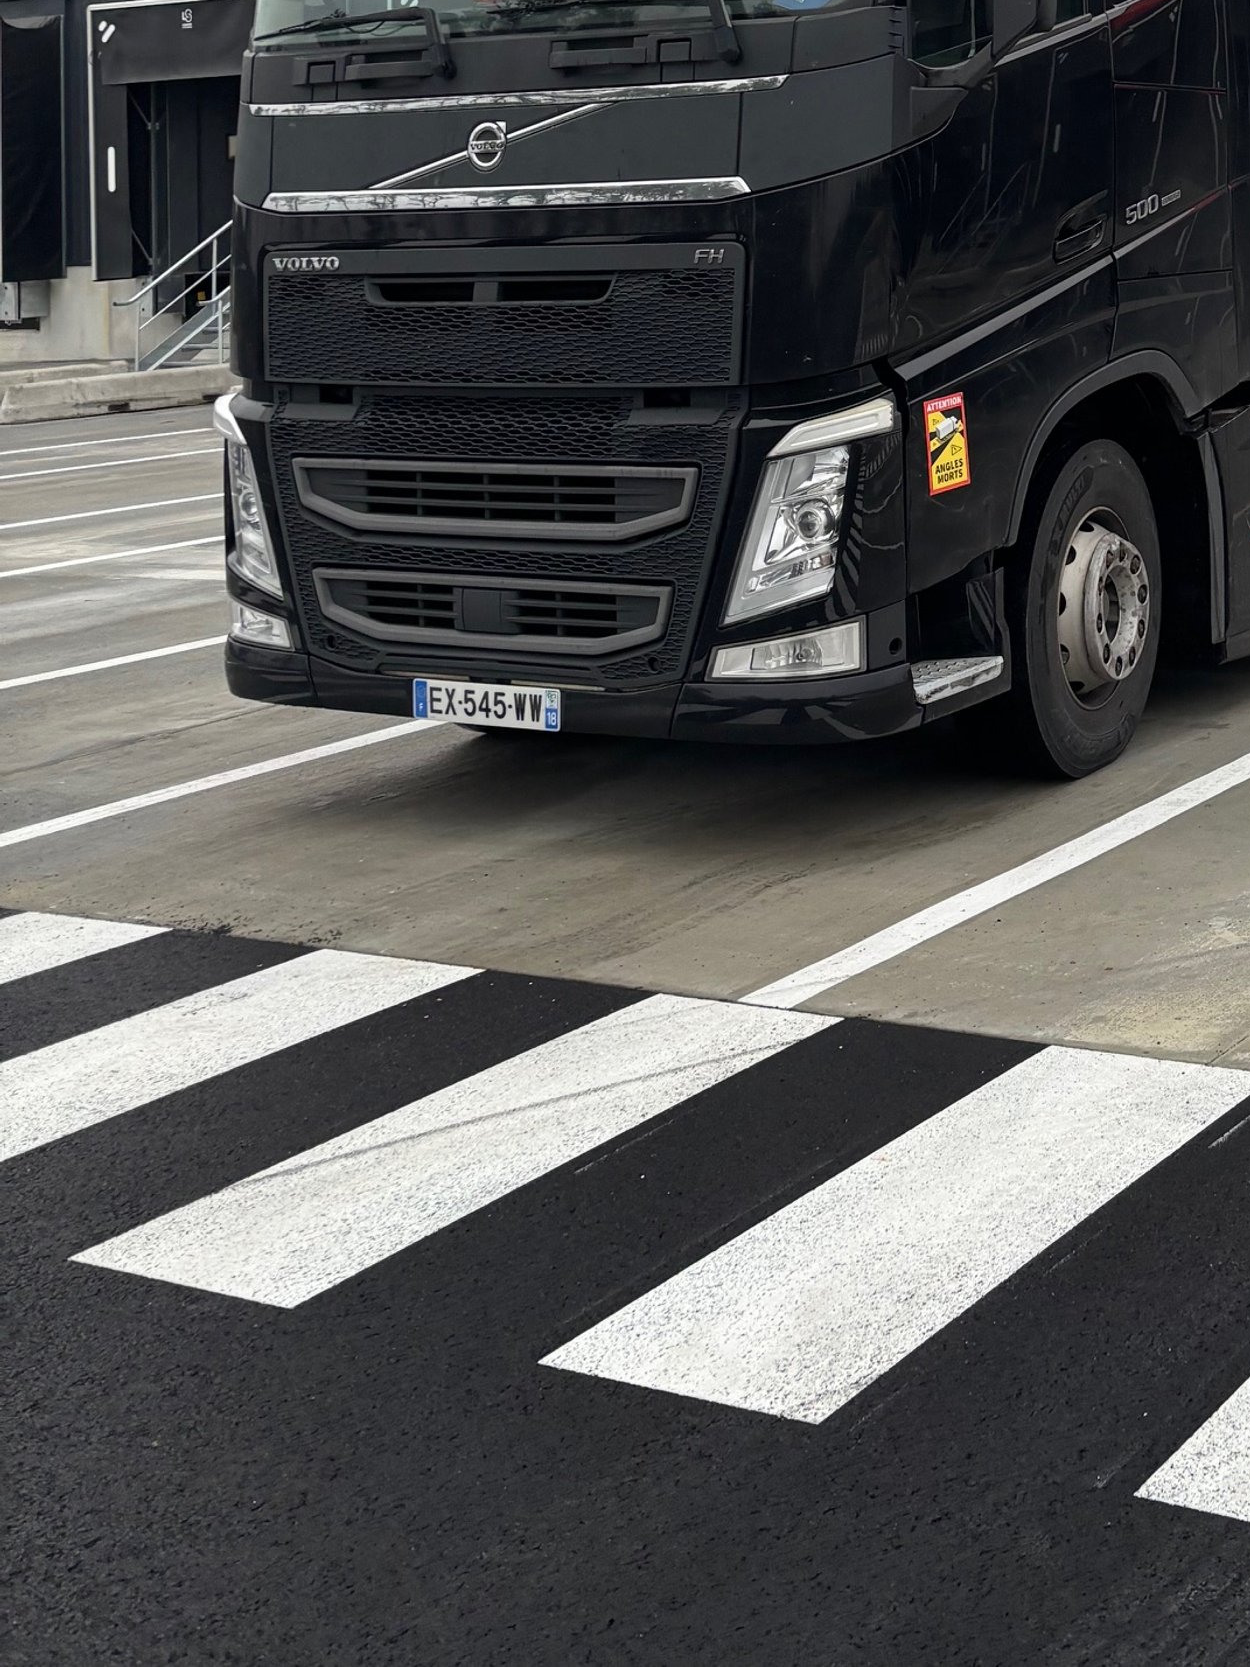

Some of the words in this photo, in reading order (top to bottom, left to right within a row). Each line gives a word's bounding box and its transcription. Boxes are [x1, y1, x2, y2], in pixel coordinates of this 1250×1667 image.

[1126, 194, 1159, 225] 500
[272, 256, 339, 272] VOLVO
[694, 249, 724, 264] FH
[926, 396, 962, 412] ATTENTION
[935, 458, 964, 474] ANGLES
[937, 469, 963, 484] MORTS
[546, 711, 557, 726] 18
